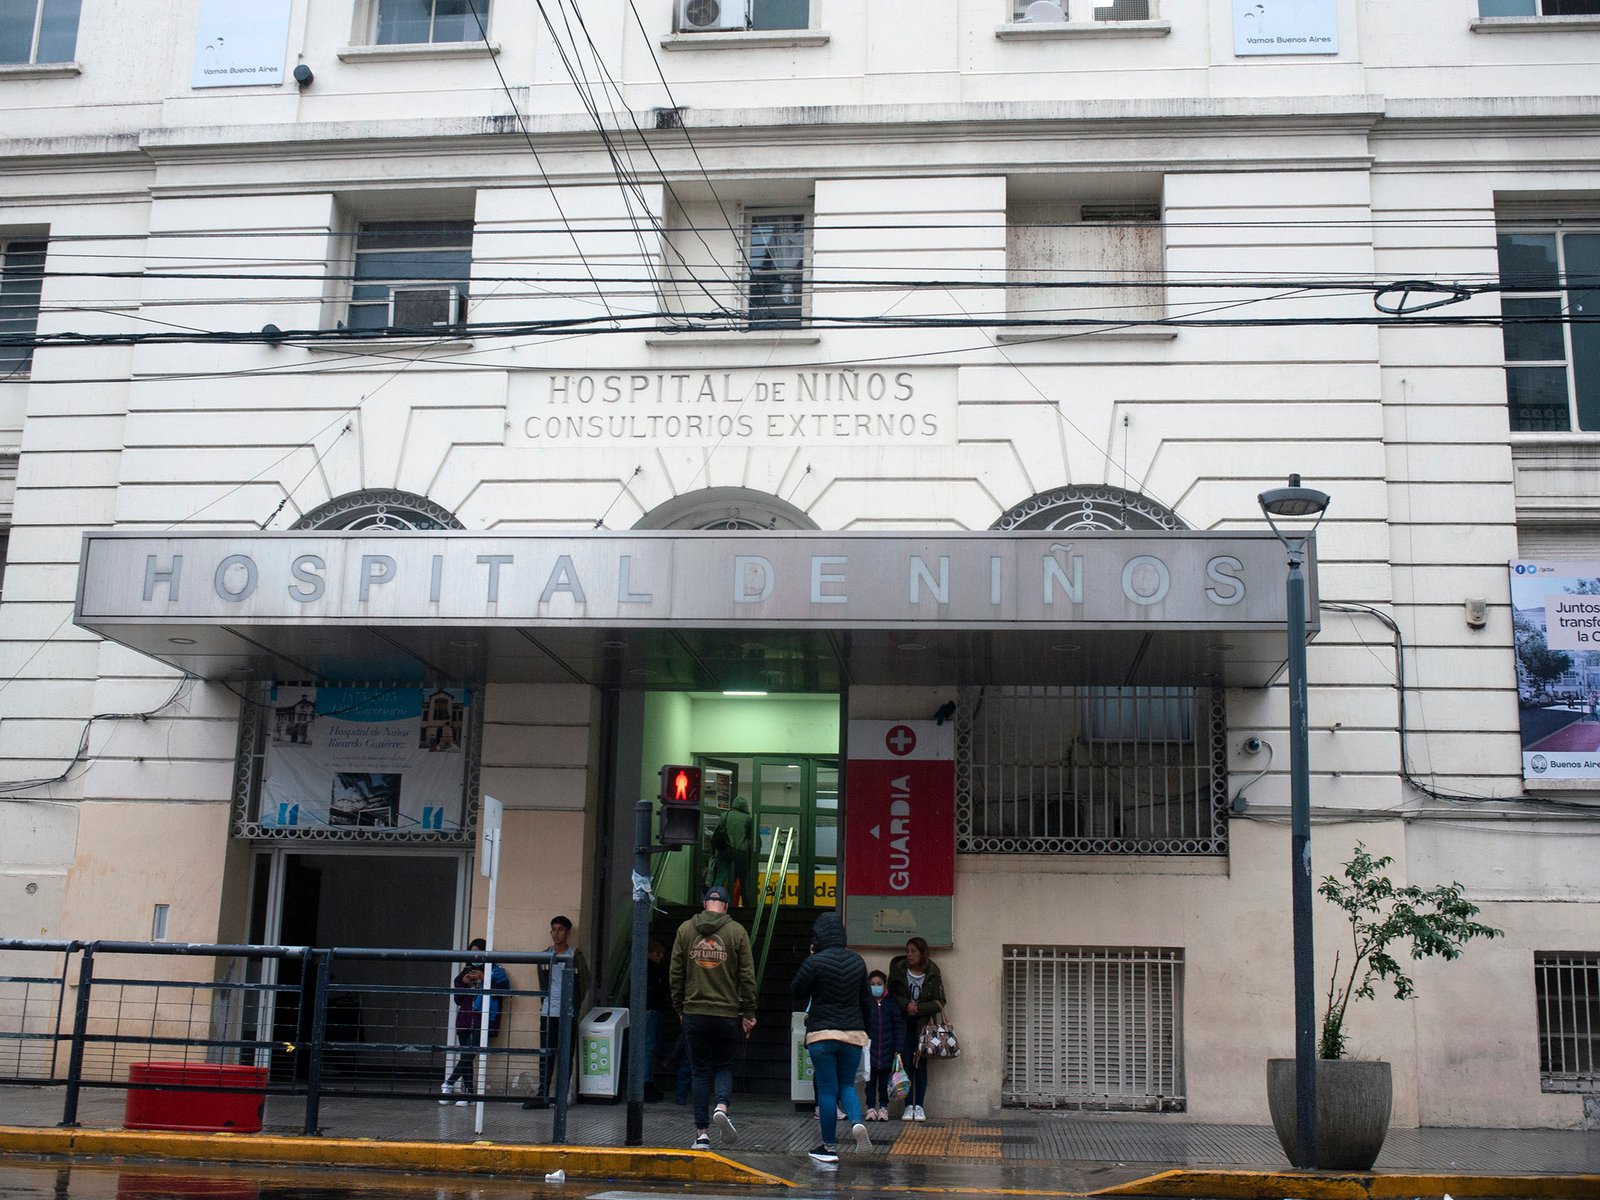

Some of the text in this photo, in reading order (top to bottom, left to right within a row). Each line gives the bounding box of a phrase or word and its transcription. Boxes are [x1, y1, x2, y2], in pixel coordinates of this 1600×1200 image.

[548, 368, 914, 404] HOSPITAL DE NIÑOS
[524, 412, 938, 439] CONSULTORIOS EXTERNOS
[142, 542, 1247, 606] HOSPITAL DE NIÑOS
[1577, 630, 1589, 642] la
[329, 726, 371, 739] Hospital
[371, 727, 382, 737] de
[1550, 760, 1582, 768] Buenos
[889, 774, 911, 891] GUARDIA
[690, 950, 728, 961] SPY LIMITED
